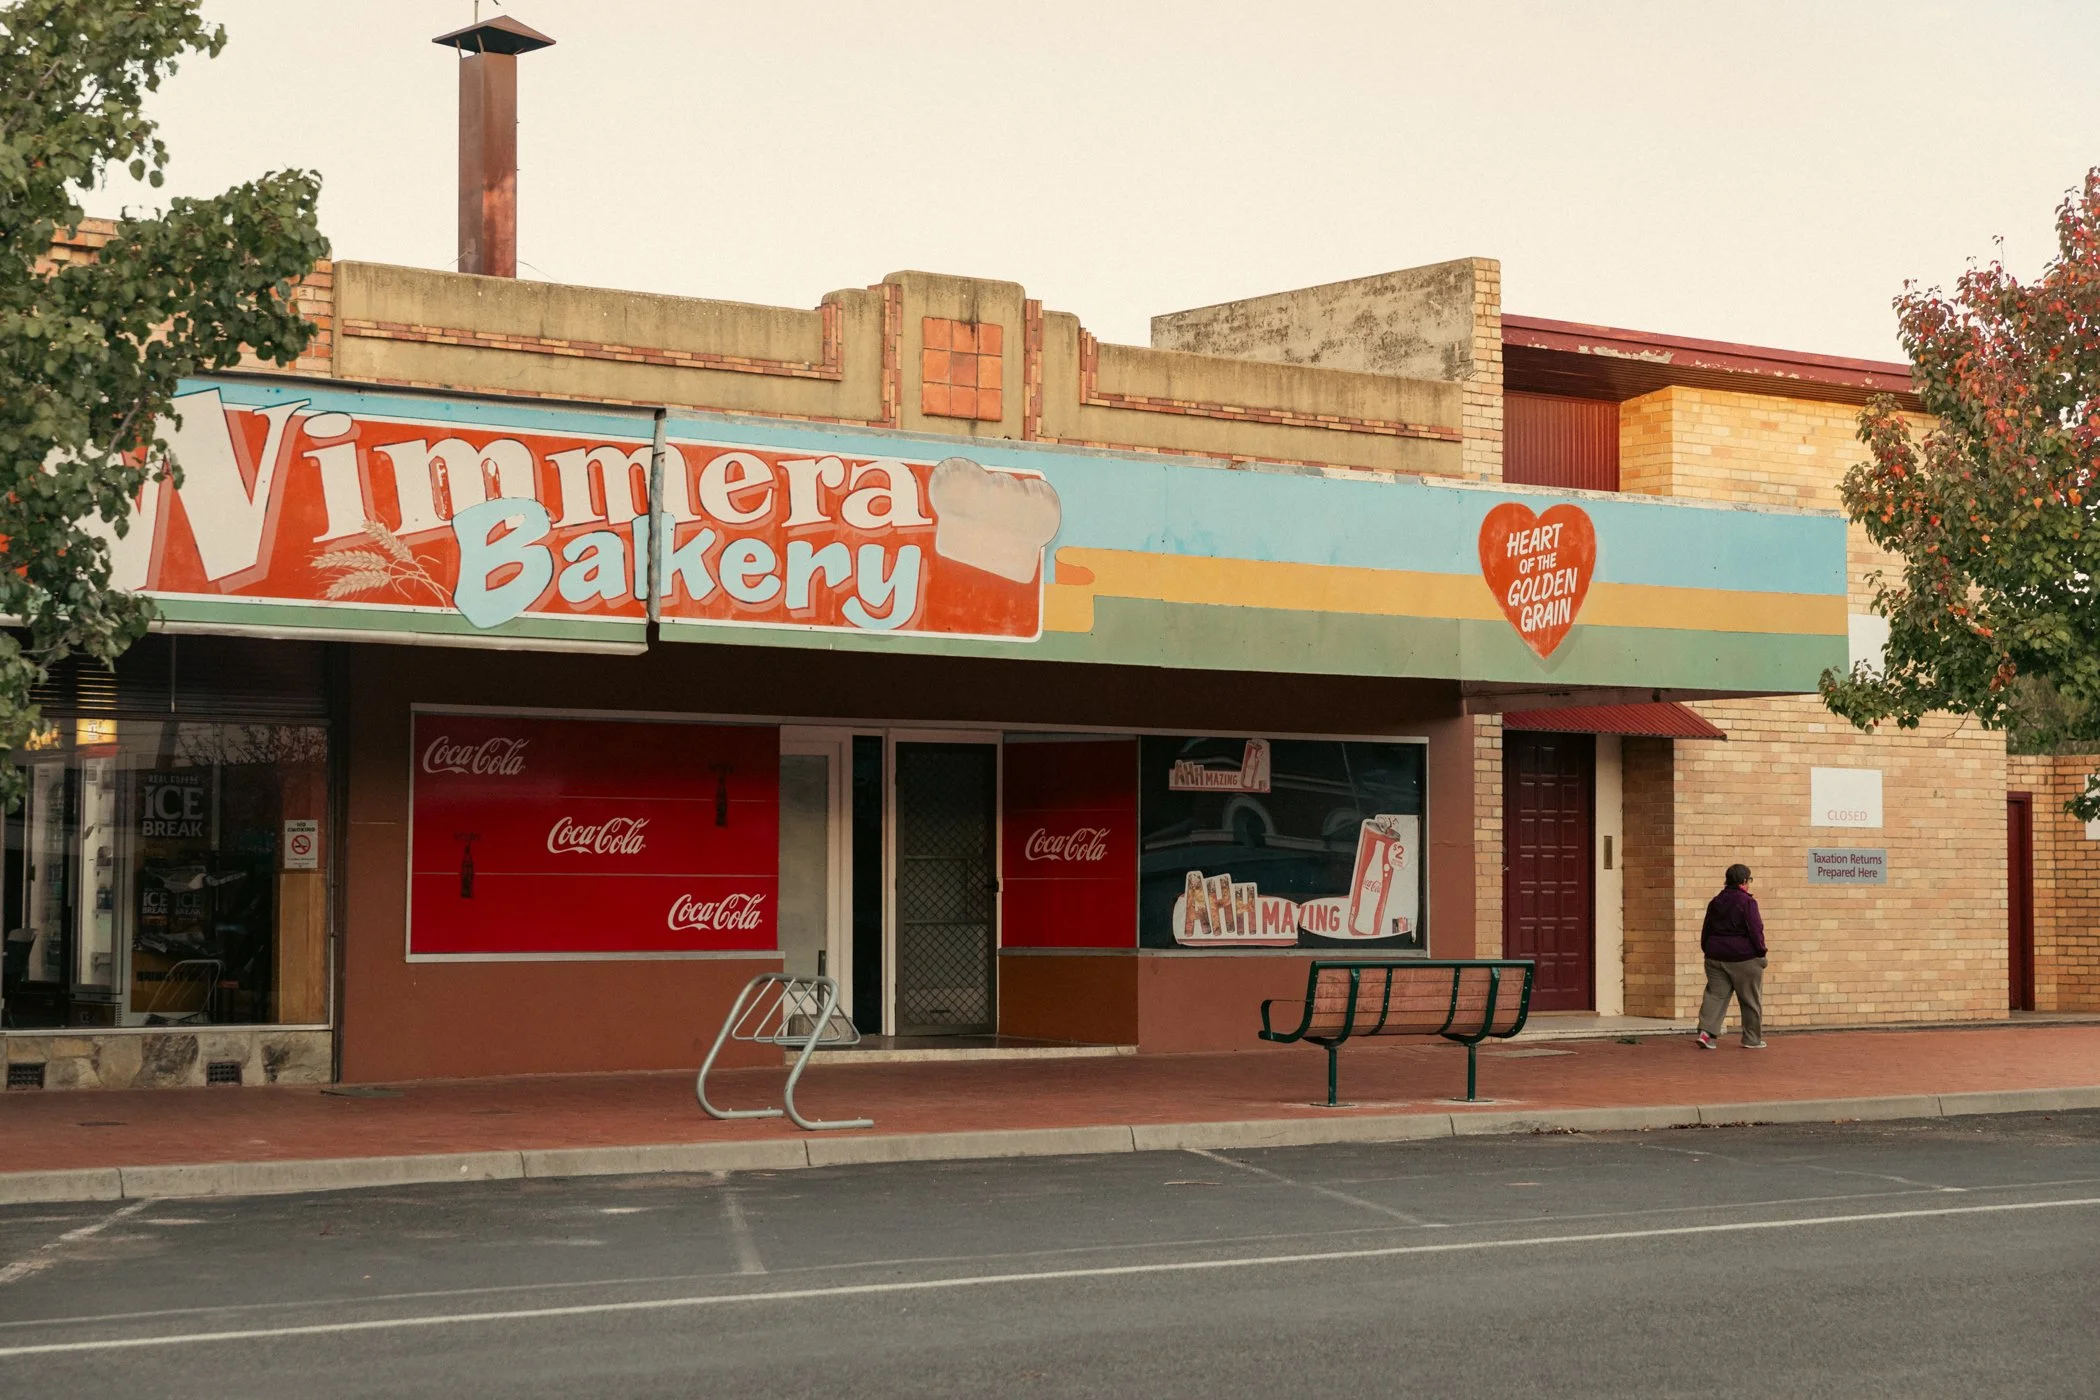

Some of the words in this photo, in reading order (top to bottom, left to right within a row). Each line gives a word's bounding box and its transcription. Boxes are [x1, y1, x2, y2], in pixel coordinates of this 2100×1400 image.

[42, 387, 933, 591] Wimmera
[1507, 523, 1563, 558] HEART
[454, 498, 922, 630] Bakery
[1519, 558, 1535, 575] OF
[1536, 552, 1557, 572] THE
[1507, 567, 1578, 607] GOLDEN
[1520, 597, 1572, 632] GRAIN
[422, 735, 529, 775] Coca-Cola
[143, 785, 204, 820] ICE
[1827, 809, 1868, 821] CLOSED
[142, 821, 203, 837] BREAK
[547, 816, 650, 855] Coca-Cola
[1025, 828, 1111, 861] Coca-Cola
[1812, 852, 1848, 864] Taxation
[1850, 853, 1882, 865] Returns
[1817, 866, 1855, 879] Prepared
[1858, 867, 1878, 878] Here
[667, 893, 767, 931] Coca-Cola
